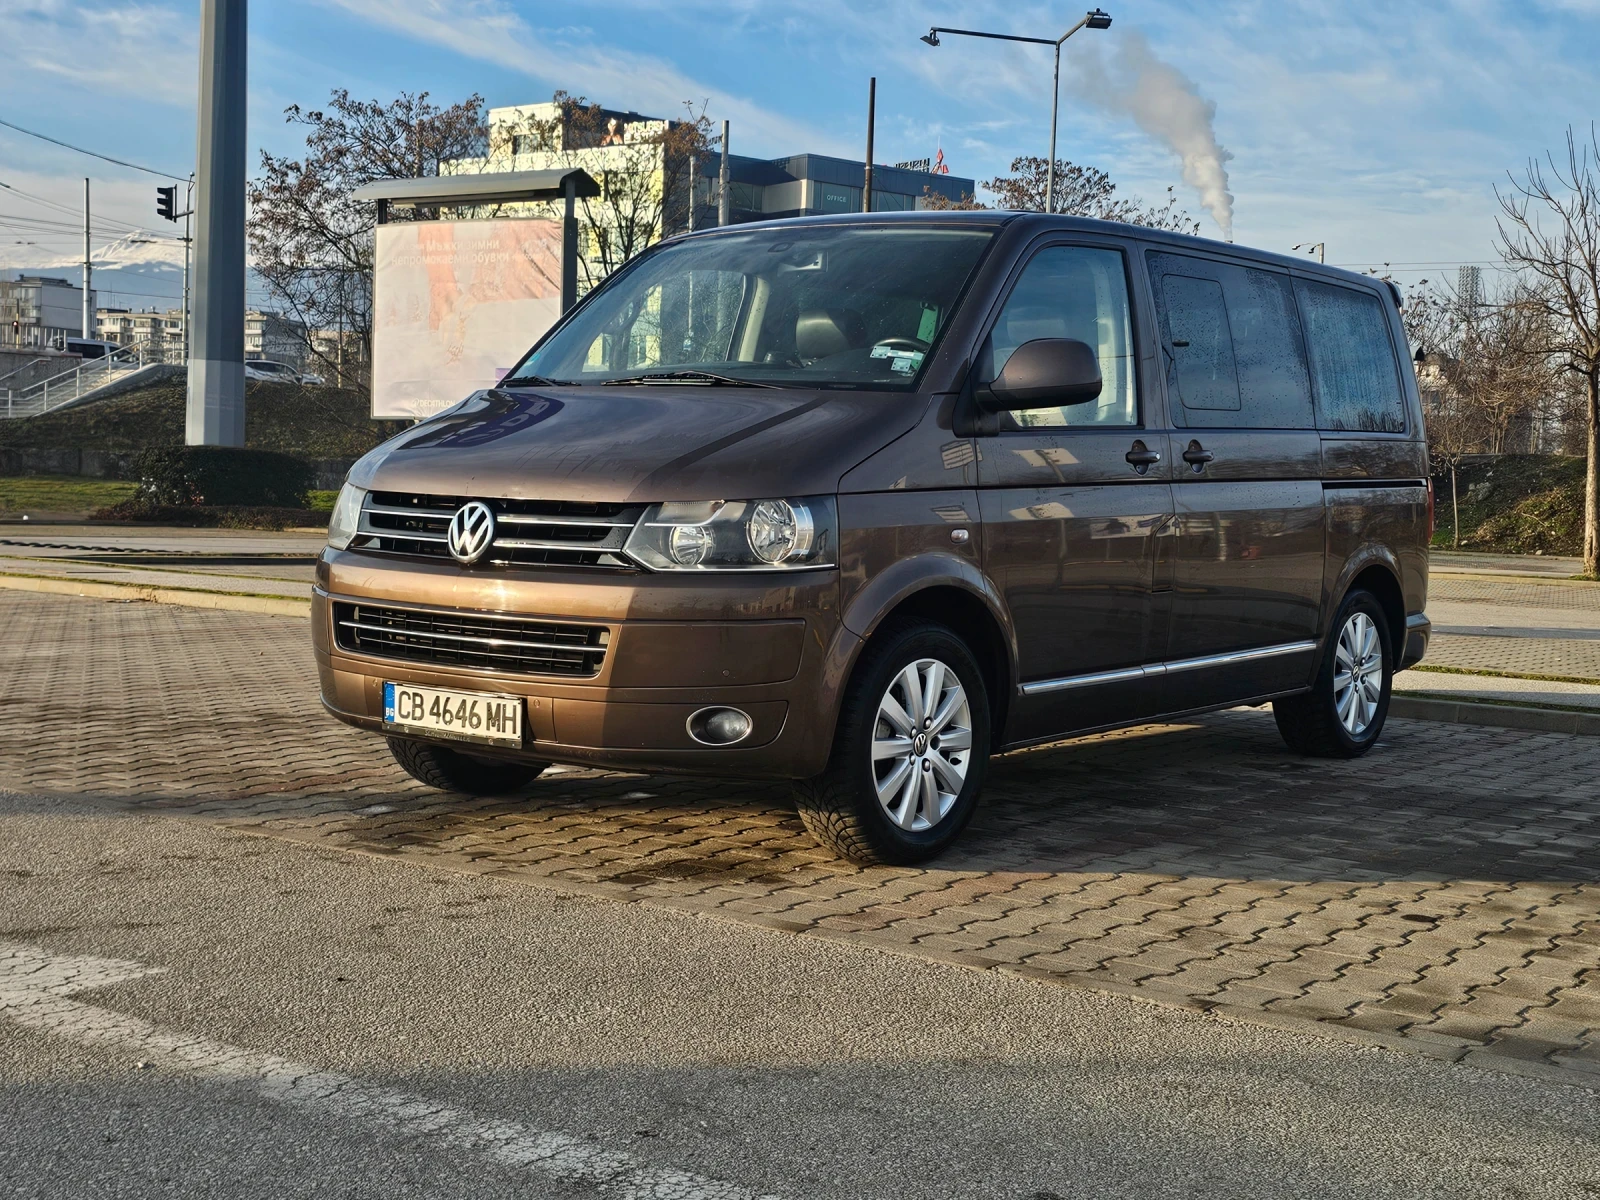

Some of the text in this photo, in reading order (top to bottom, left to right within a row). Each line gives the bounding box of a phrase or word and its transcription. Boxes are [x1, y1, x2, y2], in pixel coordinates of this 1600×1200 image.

[826, 194, 847, 203] OFFICE
[427, 240, 463, 252] Мъжки
[466, 239, 500, 250] зимни
[391, 252, 469, 267] непромокаеми
[472, 251, 509, 265] обувки
[419, 399, 456, 408] DECATHLON
[385, 707, 395, 717] BG
[429, 695, 482, 729] 4646
